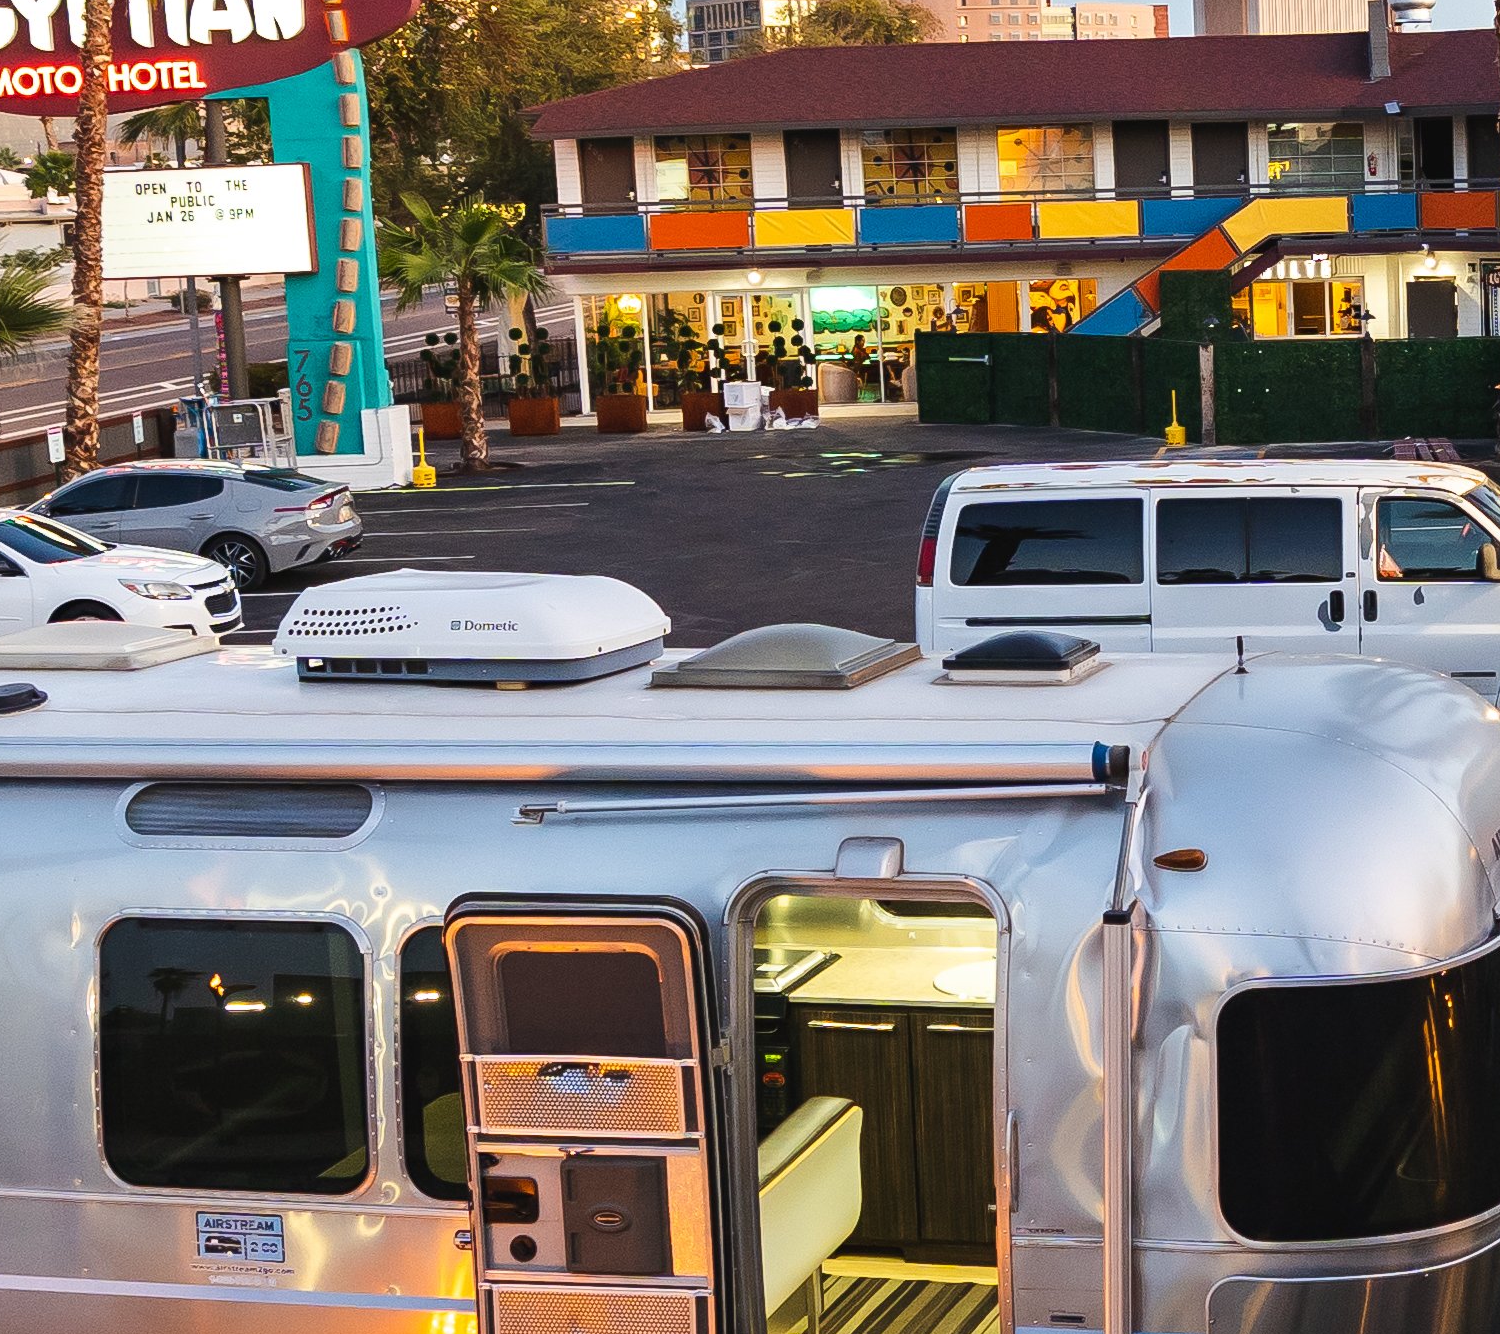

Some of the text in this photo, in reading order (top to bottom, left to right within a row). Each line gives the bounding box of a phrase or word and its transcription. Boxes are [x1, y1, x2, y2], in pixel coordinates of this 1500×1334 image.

[108, 61, 207, 92] HOTEL
[135, 179, 248, 195] OPEN TO THE
[170, 195, 216, 208] PUBLIC
[147, 208, 255, 223] JAN 26 @ 9PM
[294, 349, 314, 422] 765
[464, 620, 519, 631] Dometic
[203, 1218, 275, 1231] AIRSTREAM
[250, 1241, 259, 1253] 2
